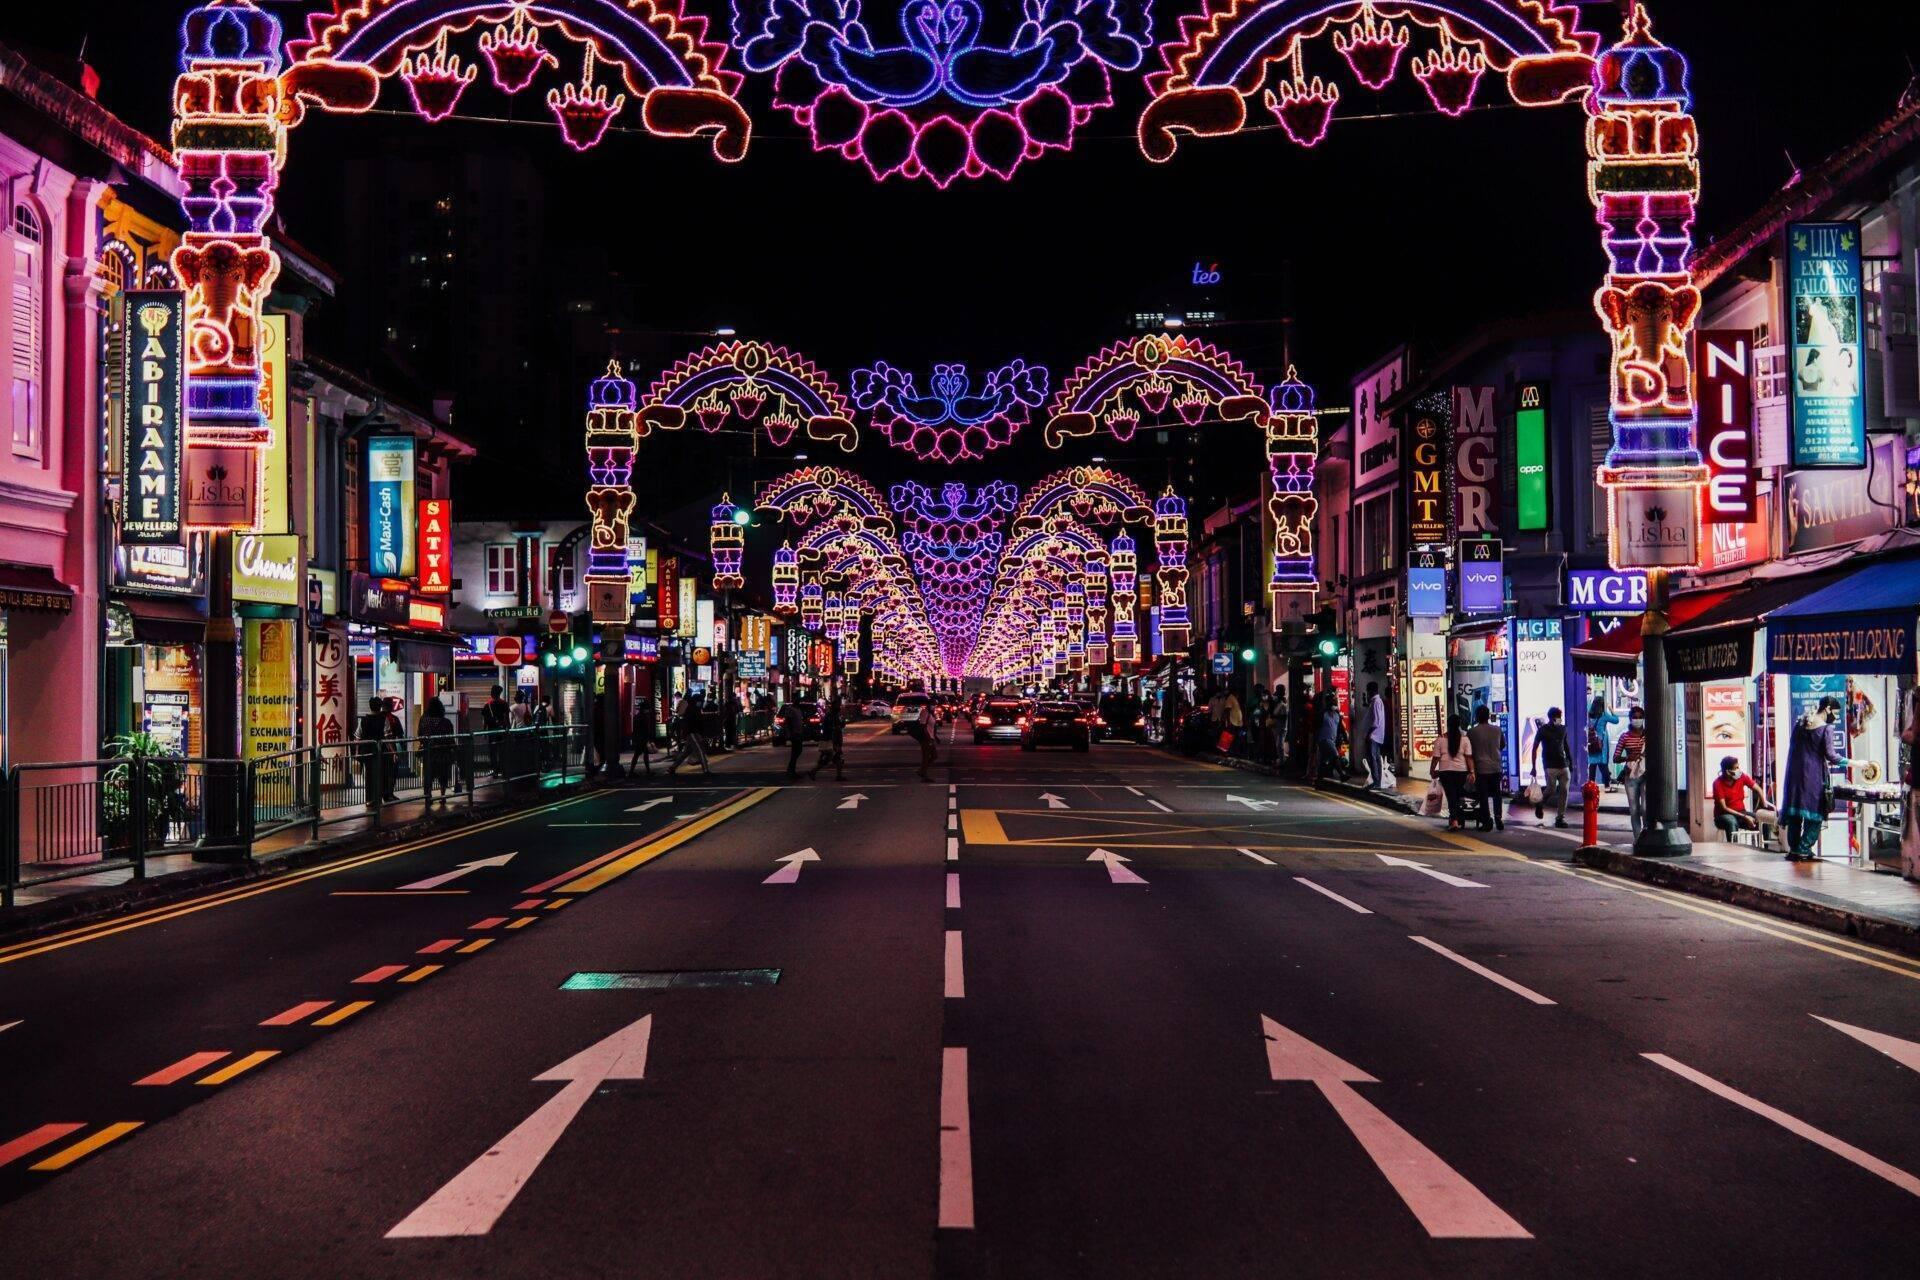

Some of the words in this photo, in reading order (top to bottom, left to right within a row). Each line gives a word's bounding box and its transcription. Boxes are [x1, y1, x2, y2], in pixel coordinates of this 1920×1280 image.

[1810, 229, 1839, 257] LILY
[1801, 259, 1849, 277] EXPRESS
[1794, 278, 1857, 294] TAILORING
[140, 338, 166, 518] ABIRAAME
[1706, 340, 1748, 512] NICE
[1457, 386, 1499, 532] MGR
[188, 480, 245, 501] Lisha
[1412, 443, 1442, 521] GMT
[123, 521, 179, 531] JEWELLERS
[379, 487, 391, 550] Maxi-Cash
[1628, 520, 1686, 542] Lisha
[1712, 523, 1747, 553] NICE
[426, 501, 442, 585] SATYA
[1412, 581, 1442, 590] vivo
[1467, 572, 1497, 583] vivo
[1570, 575, 1648, 605] MGR
[487, 607, 524, 618] Kerbau
[526, 606, 539, 617] Rd
[1517, 622, 1561, 635] MGR
[318, 638, 341, 662] 75
[1707, 641, 1739, 669] MOTORS
[1773, 634, 1796, 661] LILY
[1796, 631, 1840, 660] EXPRESS
[1842, 628, 1905, 659] TAILORING
[1519, 651, 1547, 660] OPPO
[248, 695, 260, 704] Old
[262, 695, 281, 704] Gold
[1457, 683, 1473, 696] 5G
[250, 727, 293, 738] EXCHANGE
[257, 742, 287, 752] REPAIR
